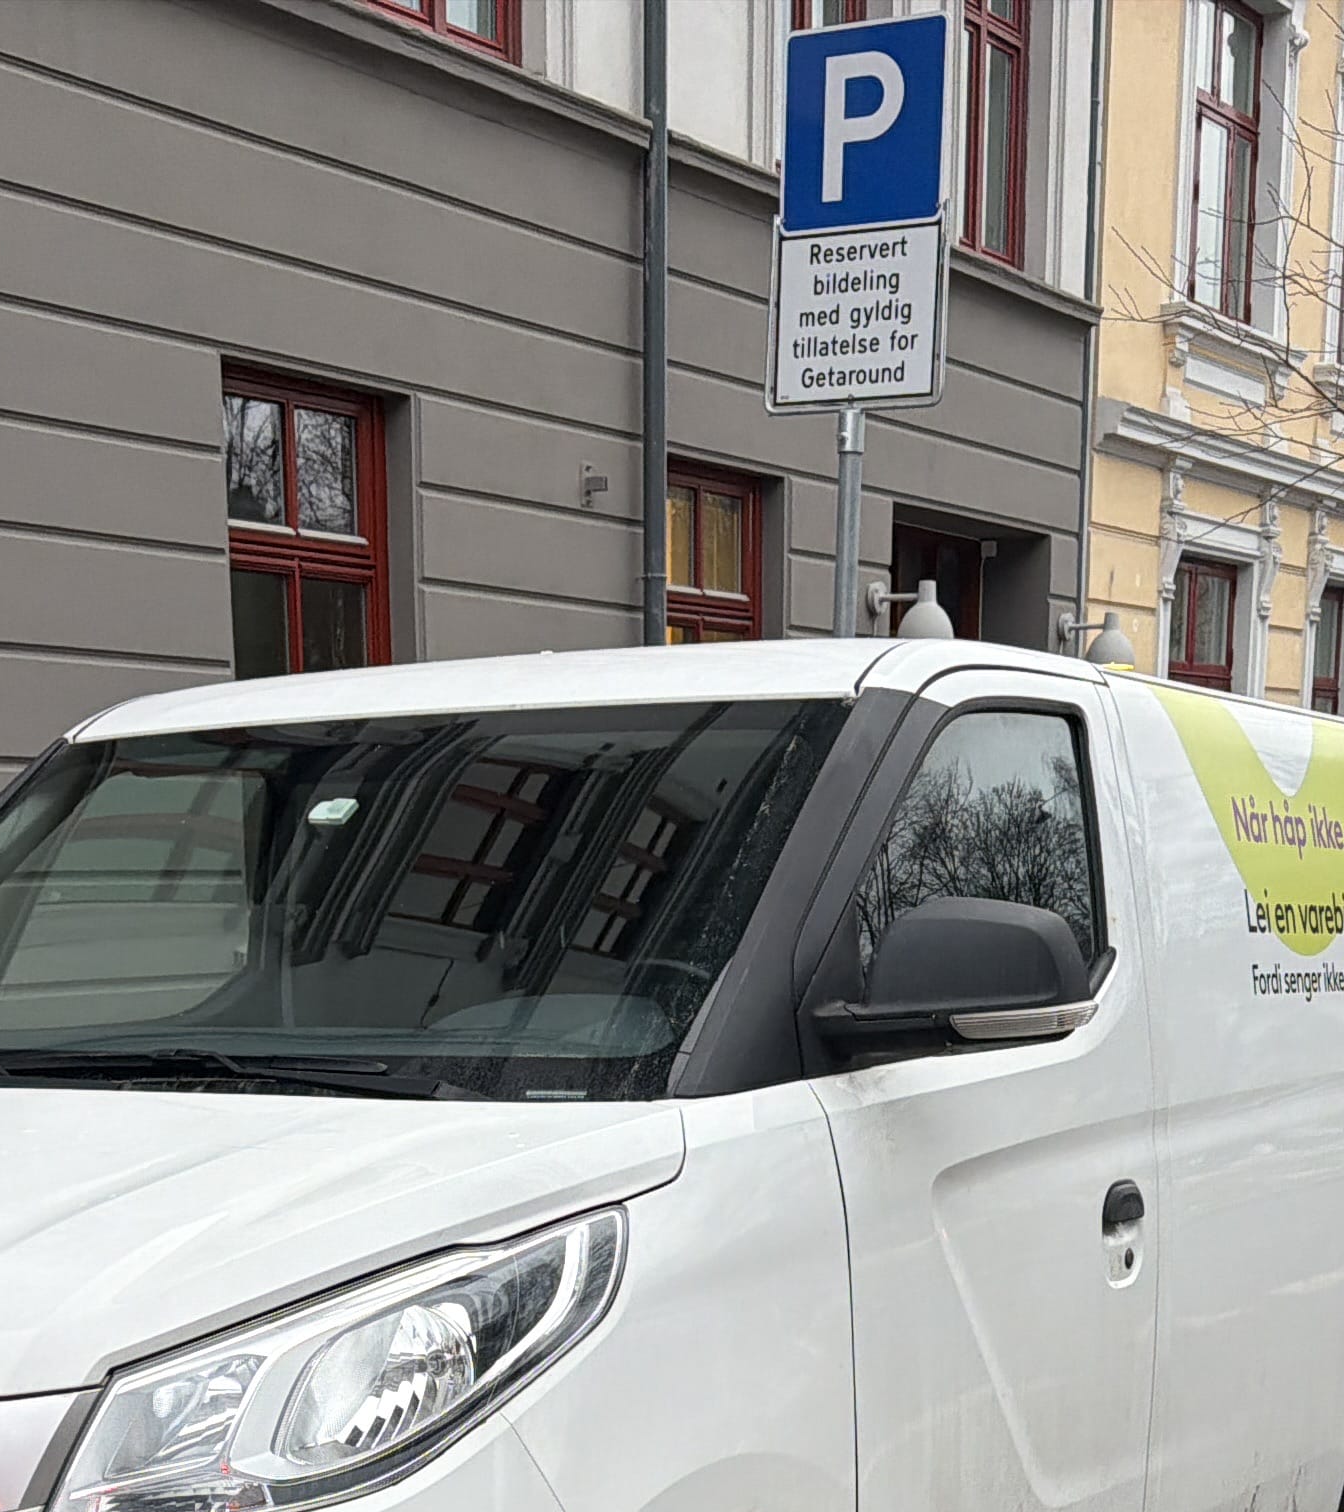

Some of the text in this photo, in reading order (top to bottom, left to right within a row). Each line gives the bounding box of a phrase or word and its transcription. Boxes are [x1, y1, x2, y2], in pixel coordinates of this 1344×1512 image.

[822, 50, 905, 203] P
[810, 235, 908, 265] Reservert
[813, 269, 900, 296] bildeling
[799, 298, 912, 329] med gyldig
[792, 329, 918, 359] tillatelse for
[801, 360, 905, 389] Getaround
[1231, 794, 1268, 844] Når
[1269, 799, 1306, 860] håp
[1308, 804, 1344, 850] ikke
[1244, 890, 1271, 933] Lei
[1274, 903, 1297, 934] en
[1252, 963, 1282, 995] Fordi
[1284, 971, 1322, 1002] senger
[1323, 962, 1344, 992] ikke
